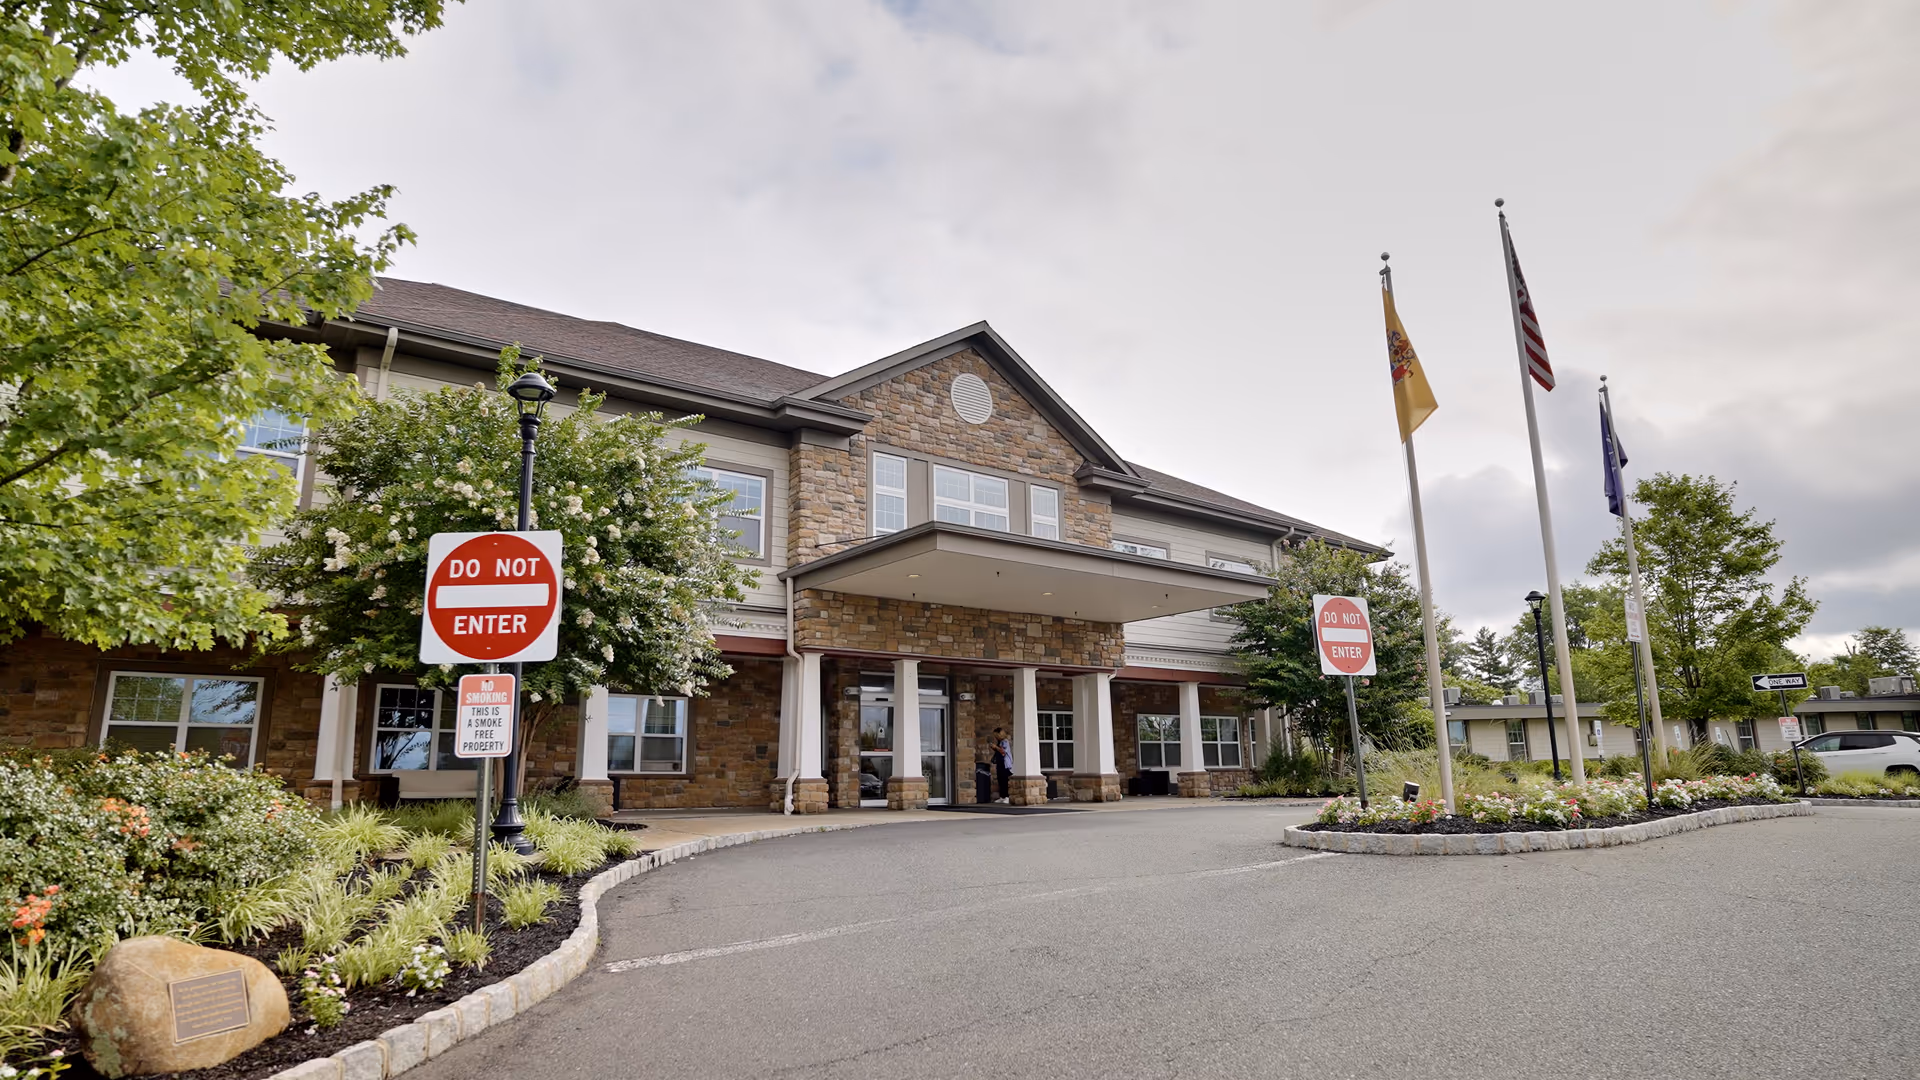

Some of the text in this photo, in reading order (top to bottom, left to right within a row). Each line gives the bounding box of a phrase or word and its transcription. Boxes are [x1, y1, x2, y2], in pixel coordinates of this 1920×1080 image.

[449, 557, 540, 578] DO NOT
[1324, 612, 1360, 624] DO NOT
[453, 614, 527, 635] ENTER
[1332, 646, 1362, 658] ENTER
[481, 680, 494, 691] NO
[466, 692, 507, 704] SMOKING
[472, 707, 499, 716] THIS IS
[467, 718, 502, 728] A SMOKE
[475, 730, 494, 739] FREE
[463, 741, 504, 751] PROPERTY
